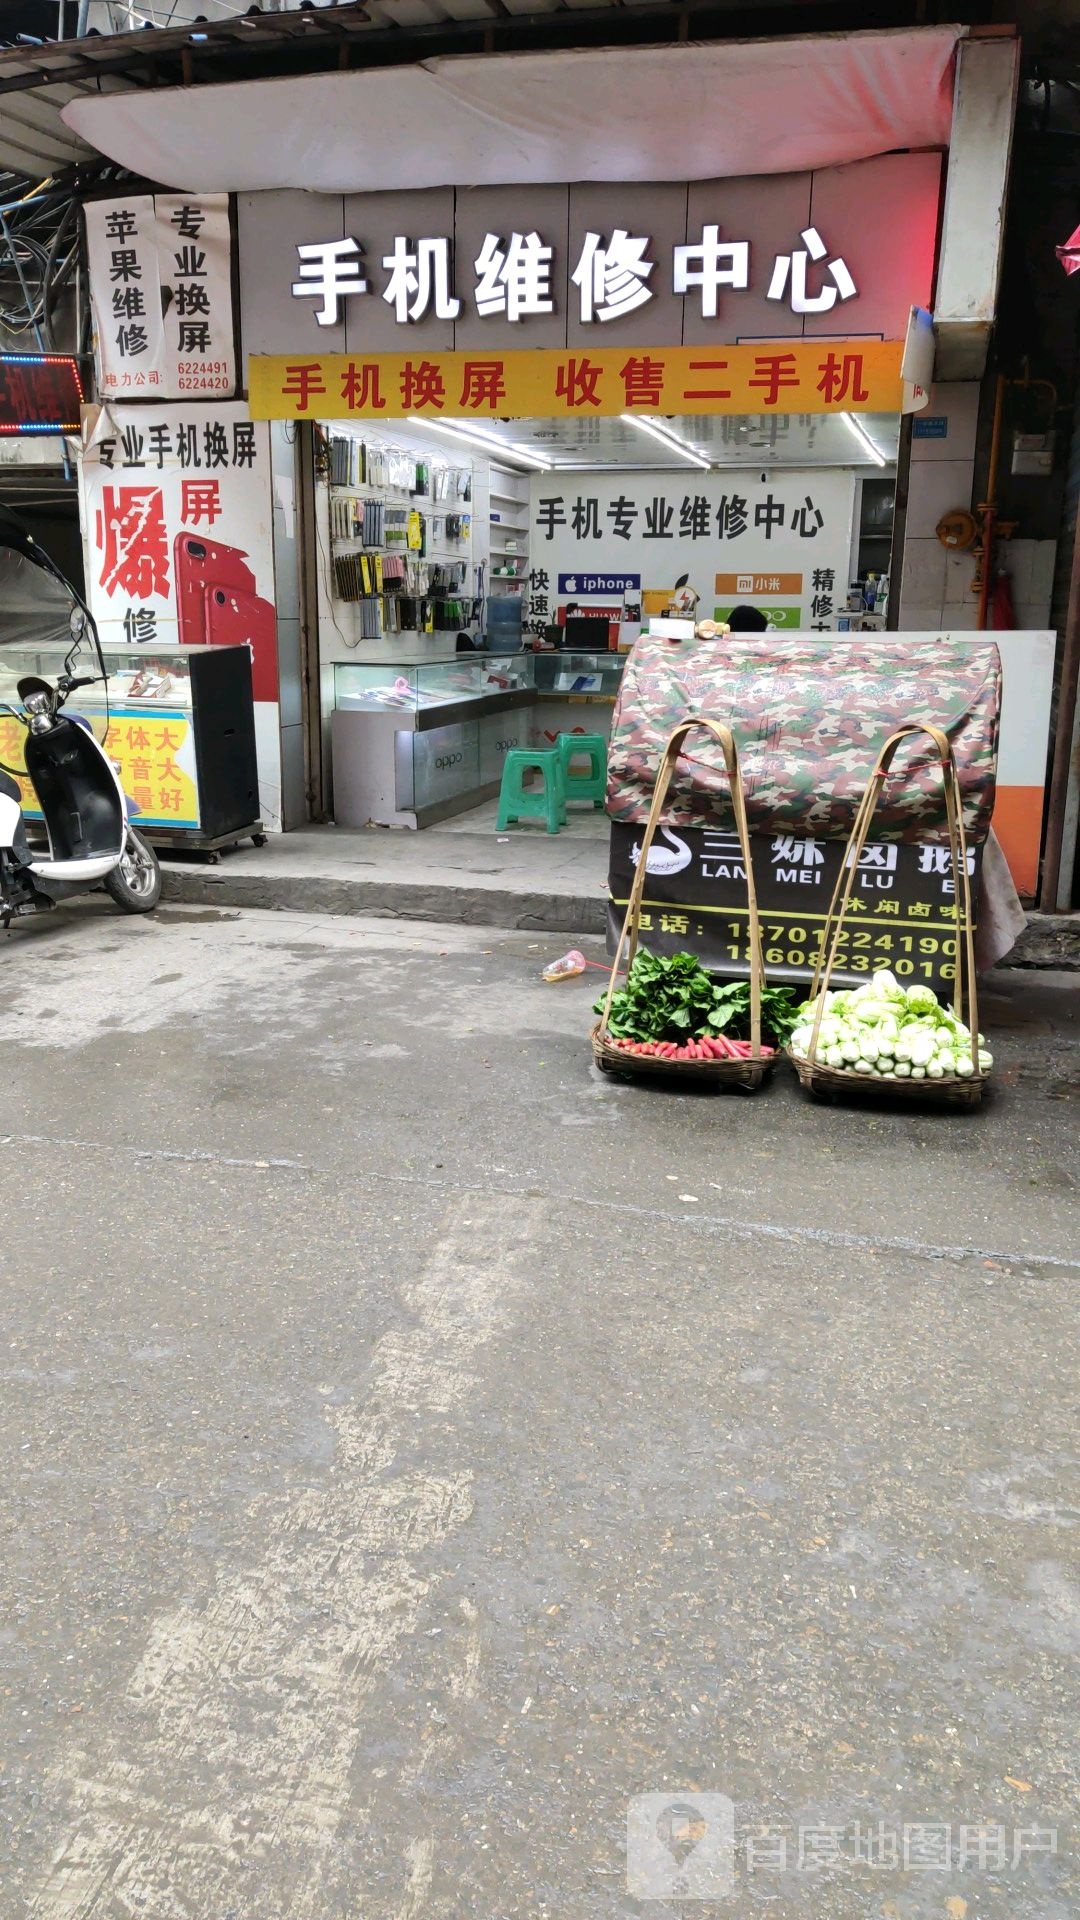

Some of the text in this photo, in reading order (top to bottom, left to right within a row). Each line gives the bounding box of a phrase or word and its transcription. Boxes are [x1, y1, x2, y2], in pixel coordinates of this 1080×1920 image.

[104, 210, 149, 357] 苹果维修
[171, 206, 212, 354] 专业换屏
[292, 224, 858, 326] 手机维修中心
[177, 361, 228, 374] 6224491
[178, 377, 229, 390] 6224420
[281, 361, 507, 410] 手机换屏
[554, 353, 869, 407] 收售二手机
[95, 420, 257, 470] 专业手机换屏
[180, 479, 223, 526] 屏
[535, 494, 825, 541] 手机专业维修中心
[583, 576, 634, 591] iphone
[755, 577, 781, 591] 小米
[122, 607, 158, 644] 修
[111, 756, 182, 782] 音大
[776, 868, 821, 885] MEI
[861, 874, 894, 889] LU
[840, 897, 967, 920] 休闲卤味
